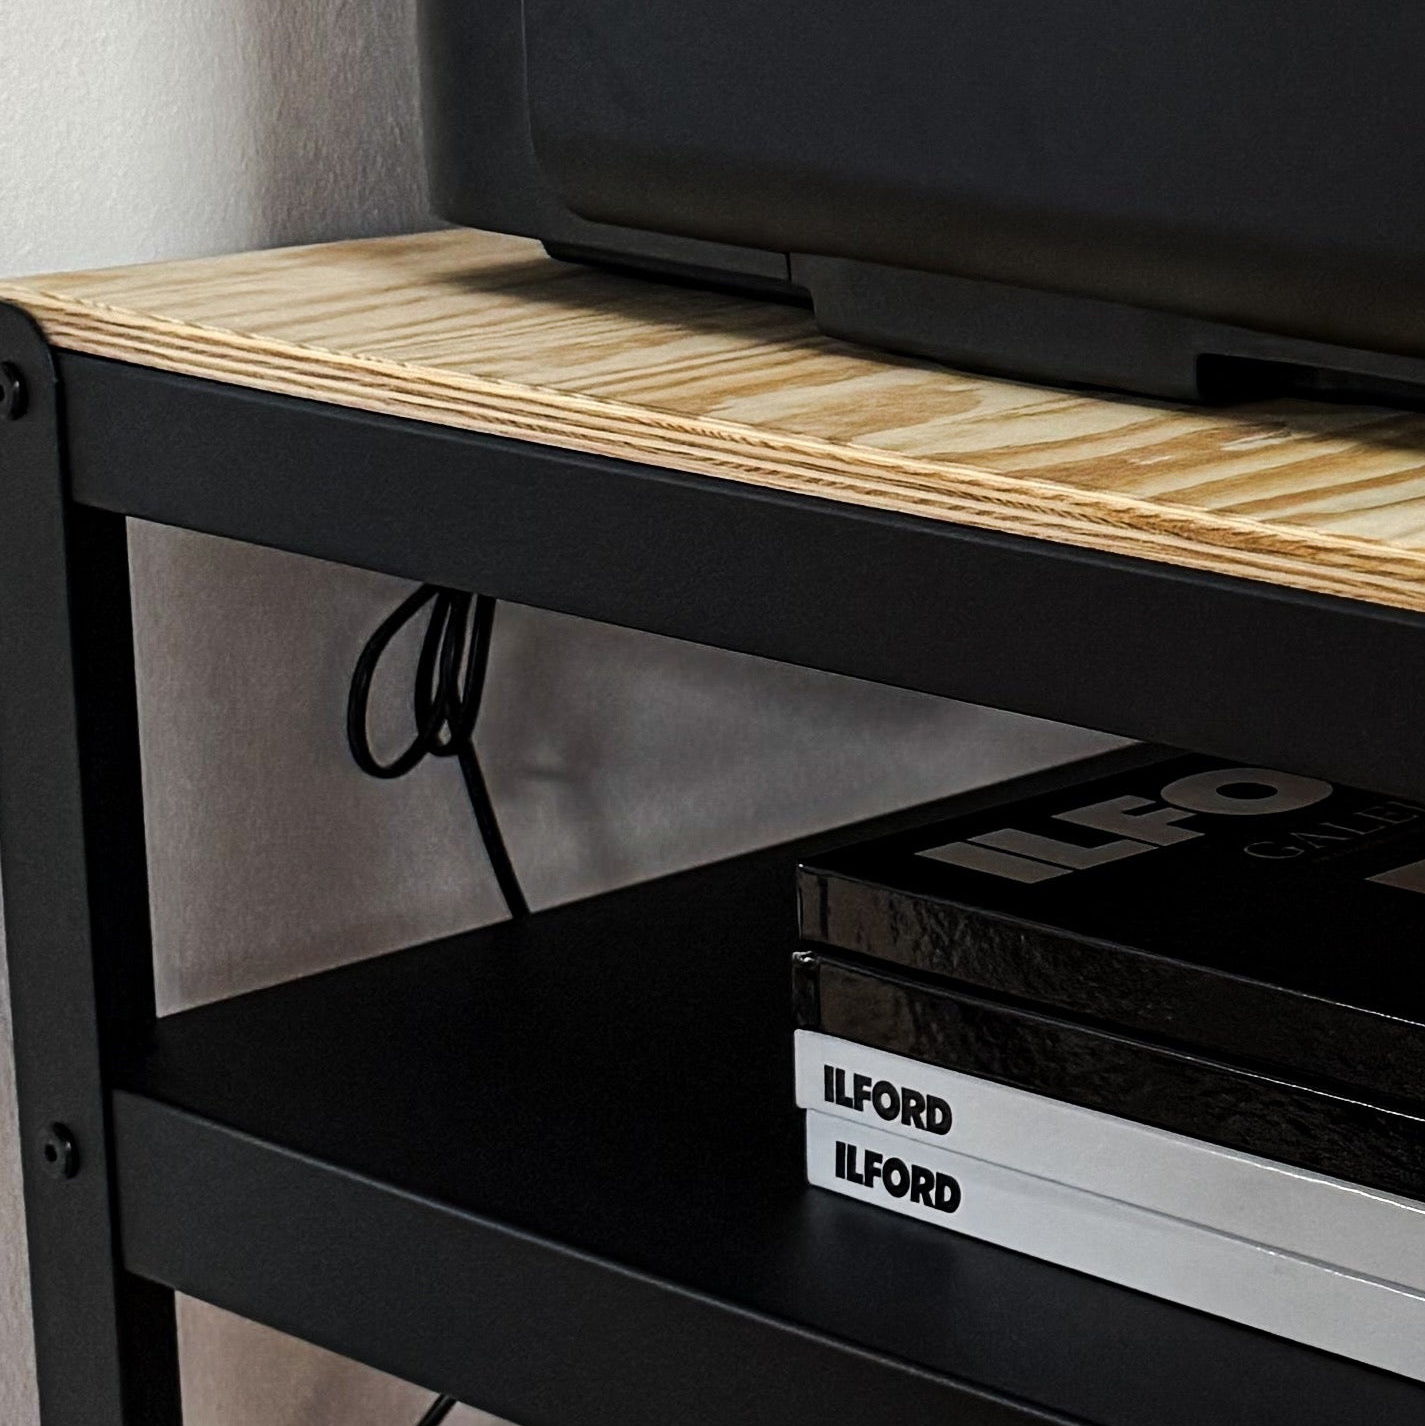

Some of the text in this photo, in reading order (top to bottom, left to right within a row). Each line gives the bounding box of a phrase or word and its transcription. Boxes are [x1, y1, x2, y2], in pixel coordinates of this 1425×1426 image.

[914, 767, 1334, 884] ILFO
[824, 1065, 953, 1136] ILFORD
[836, 1141, 961, 1214] ILFORD
